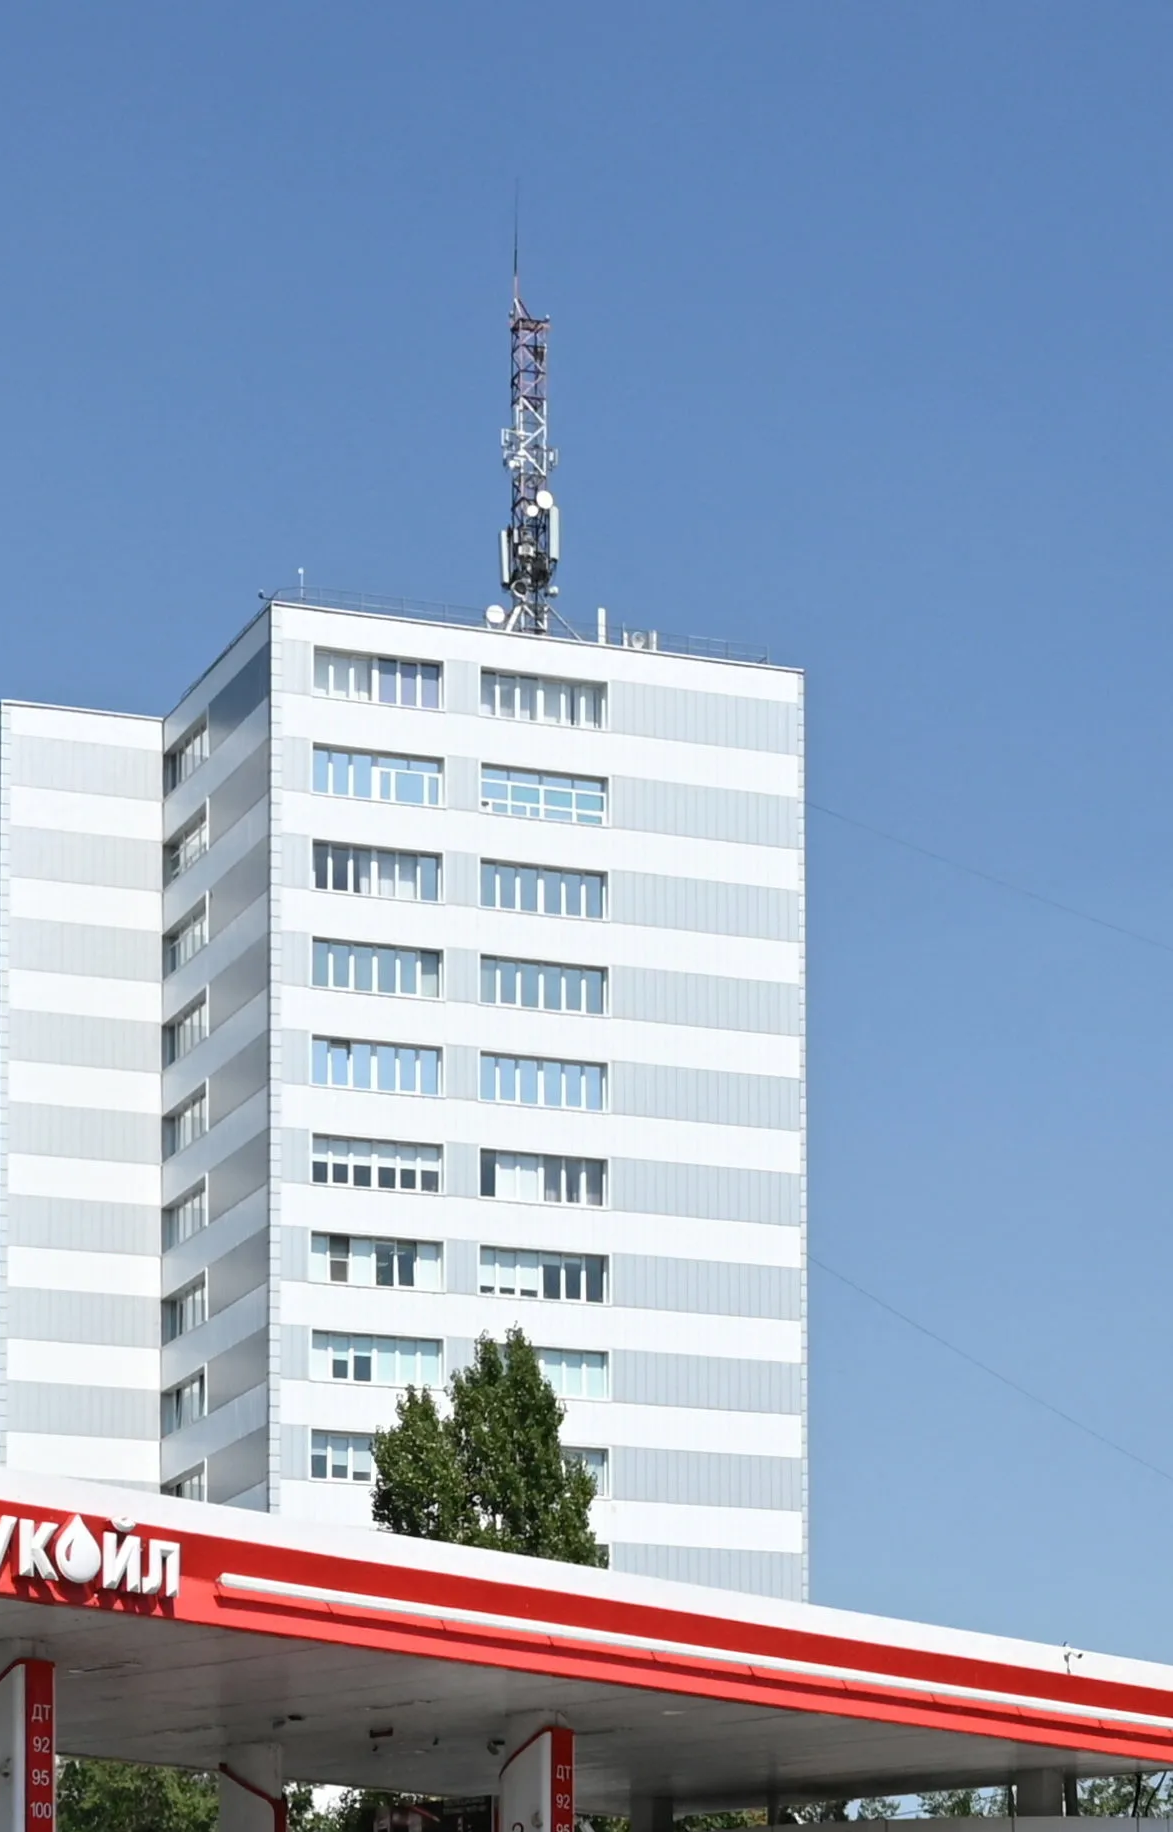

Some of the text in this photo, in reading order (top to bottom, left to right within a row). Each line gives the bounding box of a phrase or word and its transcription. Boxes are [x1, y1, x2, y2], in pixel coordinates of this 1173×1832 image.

[31, 1703, 52, 1723] ДТ
[32, 1736, 51, 1754] 92
[32, 1768, 50, 1786] 95
[555, 1764, 571, 1782] ДТ
[29, 1801, 52, 1819] 100
[555, 1792, 571, 1810] 92
